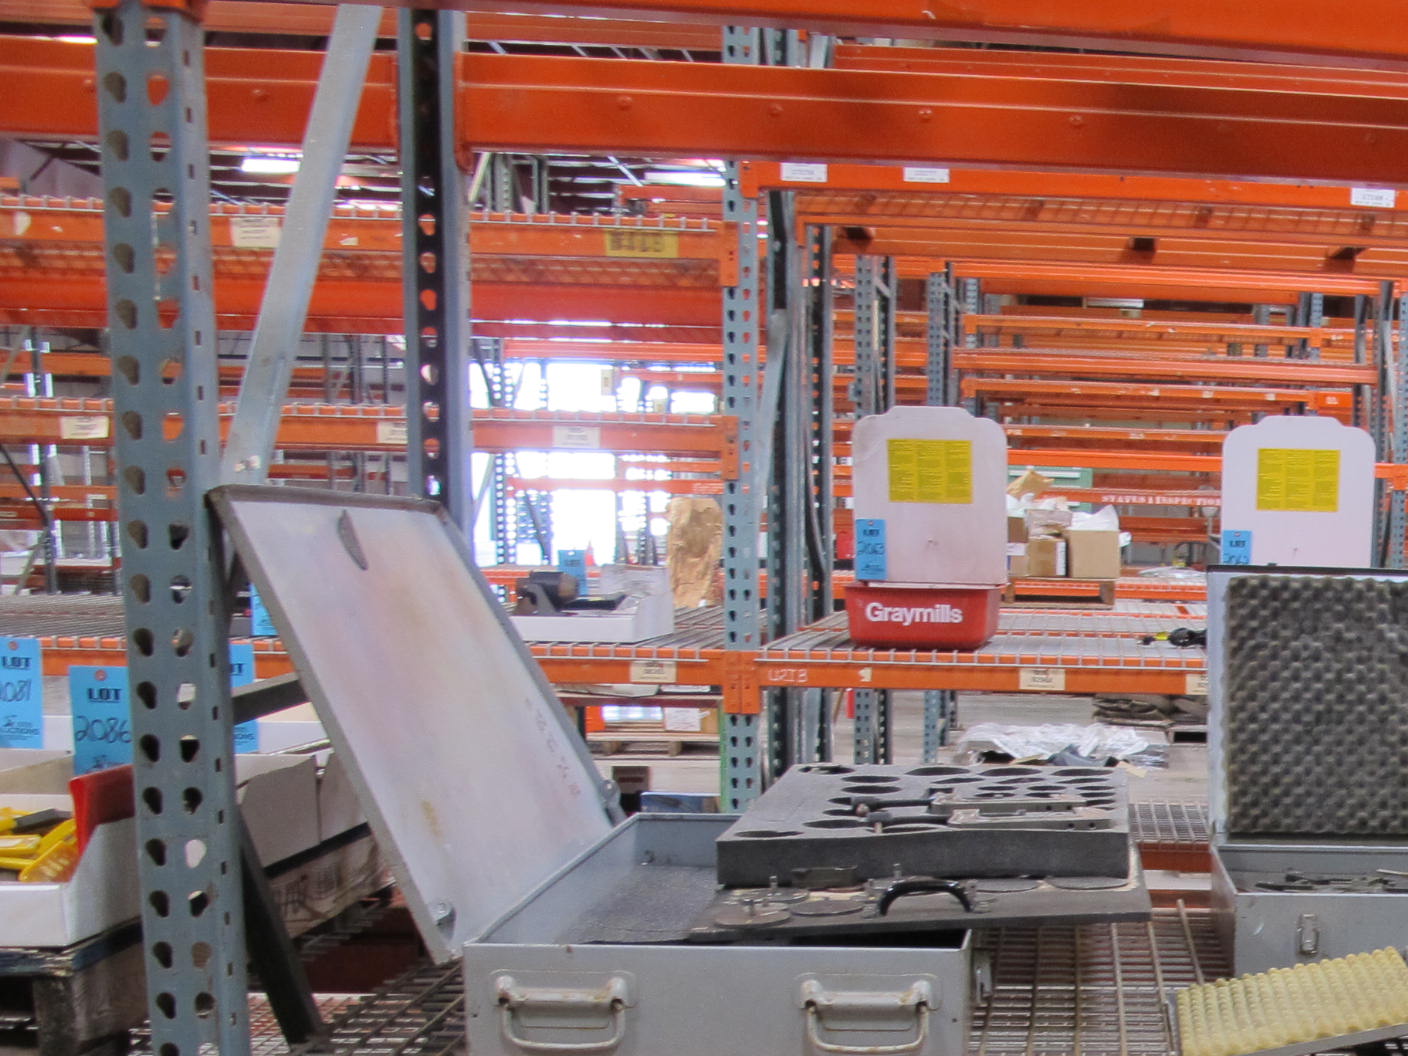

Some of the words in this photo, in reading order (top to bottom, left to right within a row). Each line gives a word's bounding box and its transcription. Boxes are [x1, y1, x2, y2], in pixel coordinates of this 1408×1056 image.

[866, 602, 963, 626] Graymills
[2, 656, 31, 667] LOT
[87, 688, 122, 701] LOT
